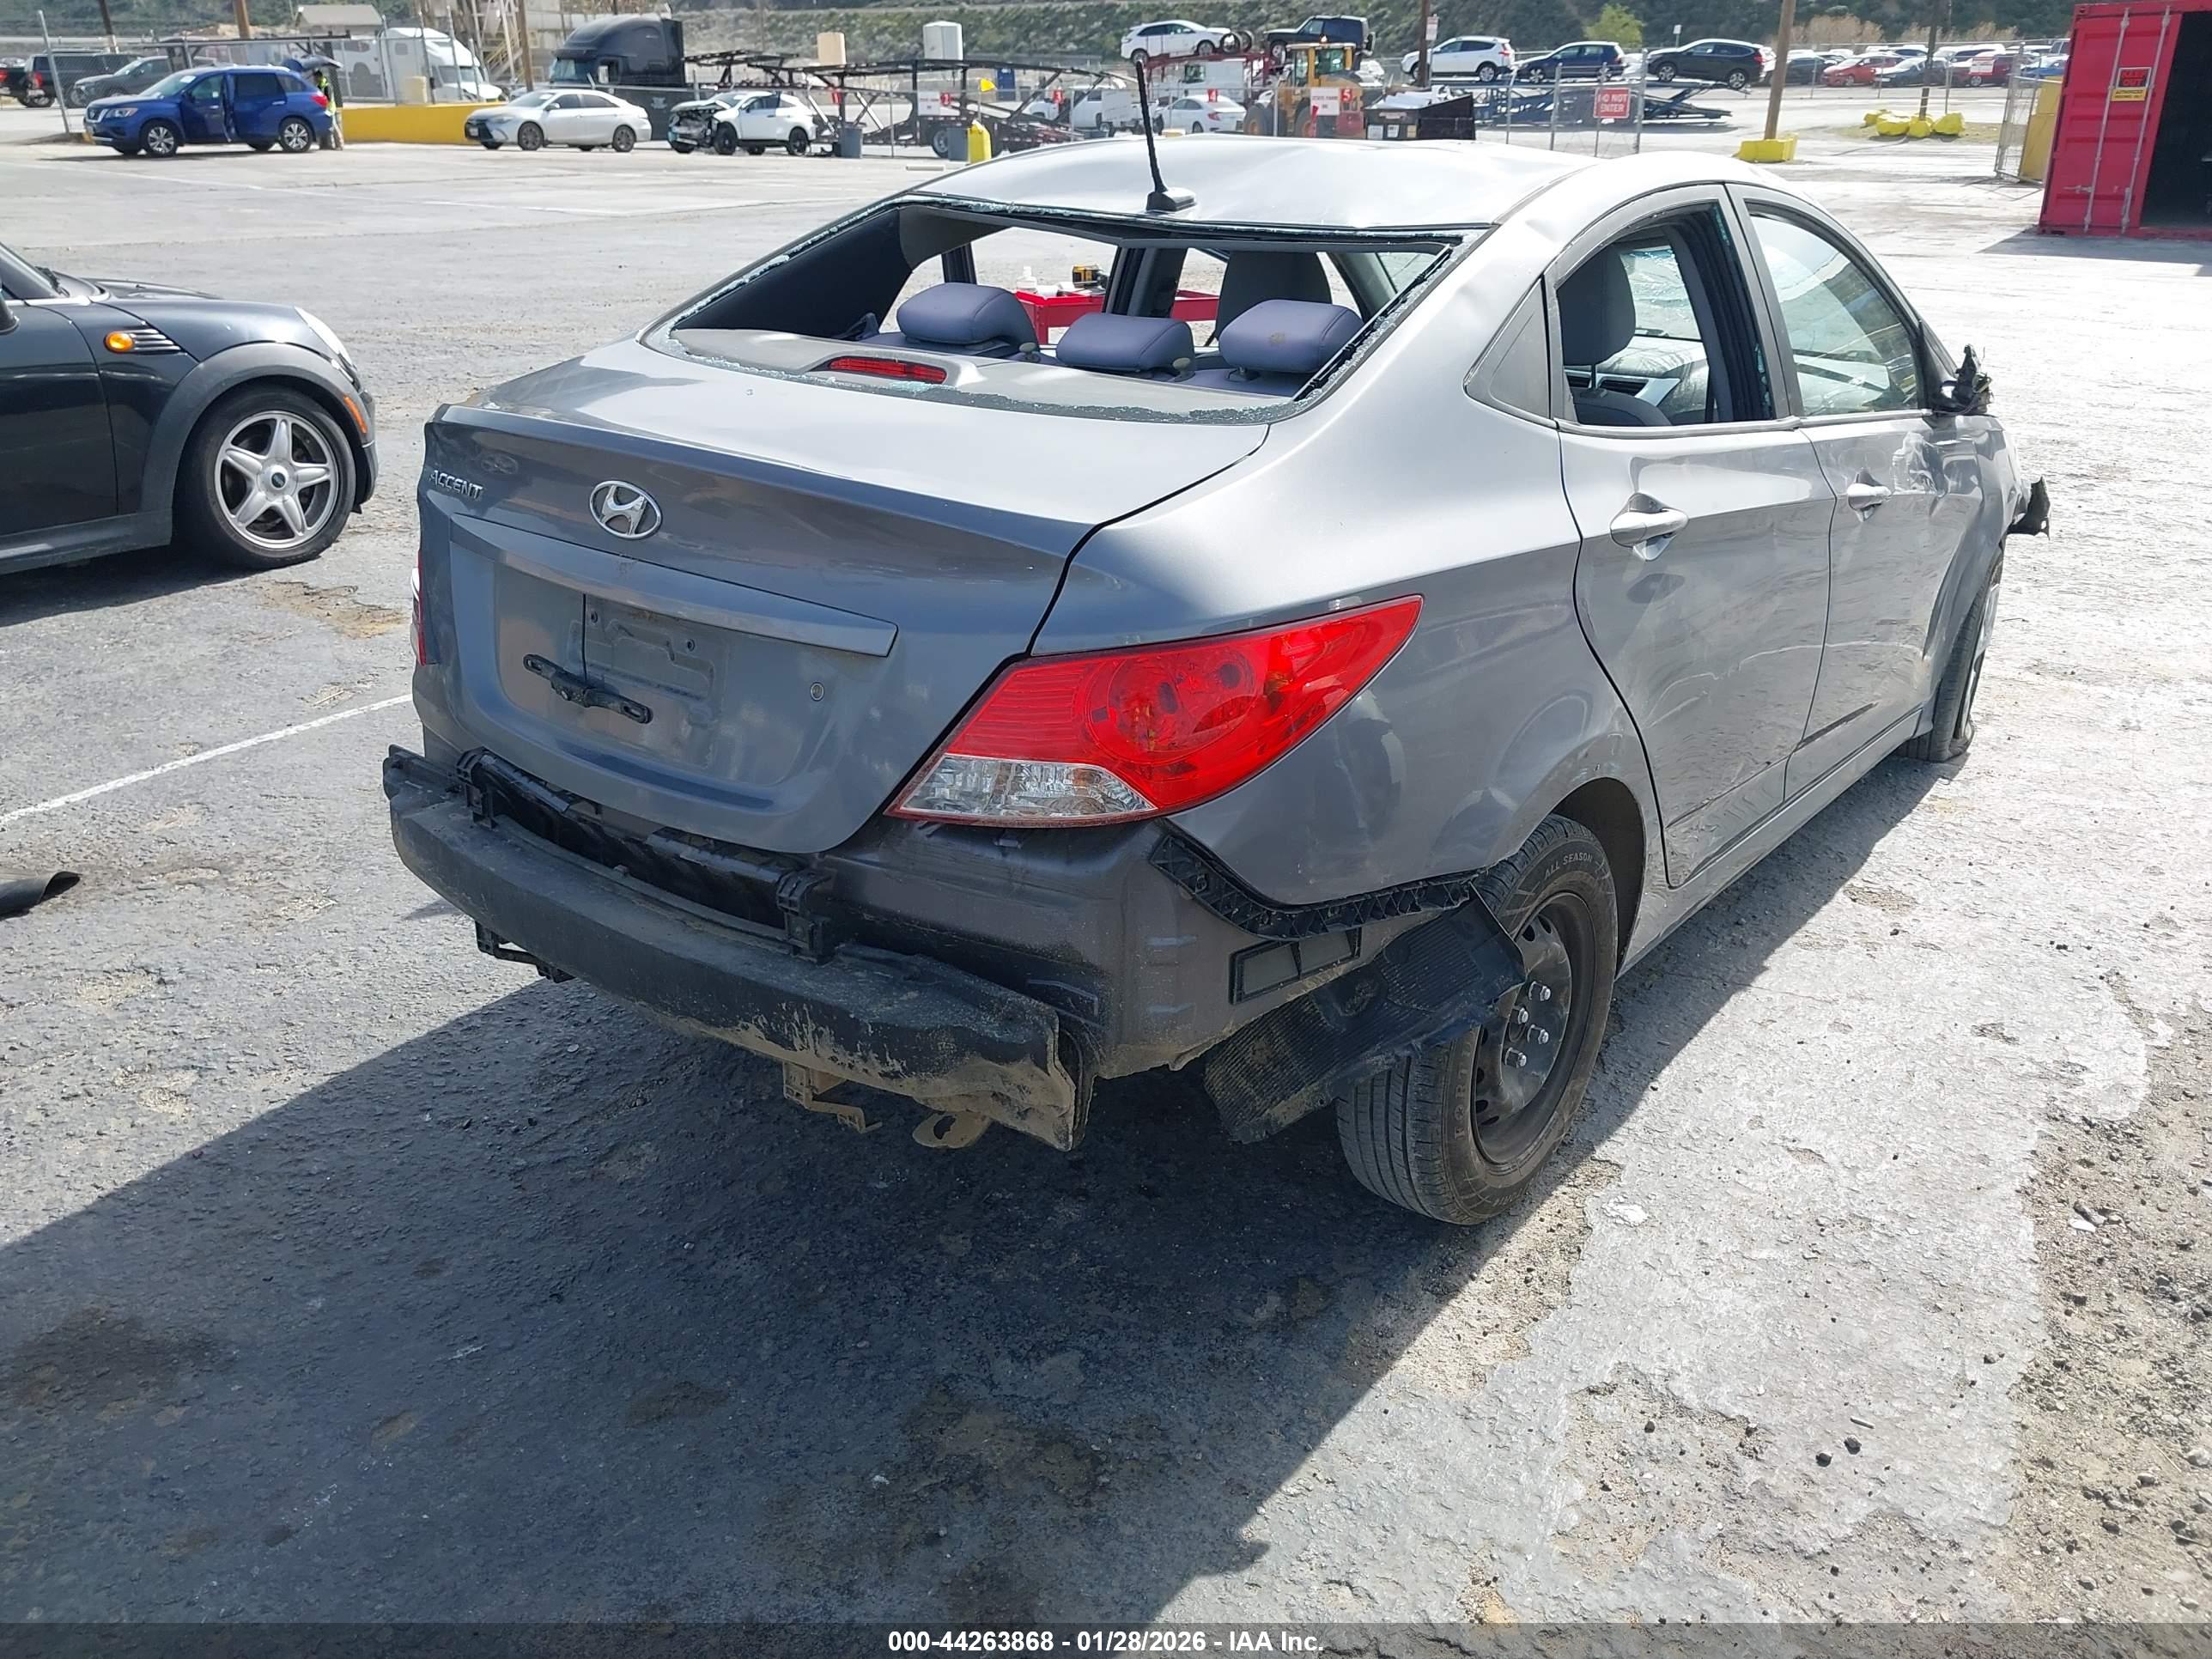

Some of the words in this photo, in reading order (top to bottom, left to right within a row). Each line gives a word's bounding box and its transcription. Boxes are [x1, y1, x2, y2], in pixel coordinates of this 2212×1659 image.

[1342, 88, 1351, 101] 5
[1611, 94, 1627, 103] NOT
[1600, 103, 1625, 112] ENTER
[428, 470, 483, 499] ACCENT
[1544, 860, 1560, 881] ALL
[1562, 852, 1593, 866] SEASON
